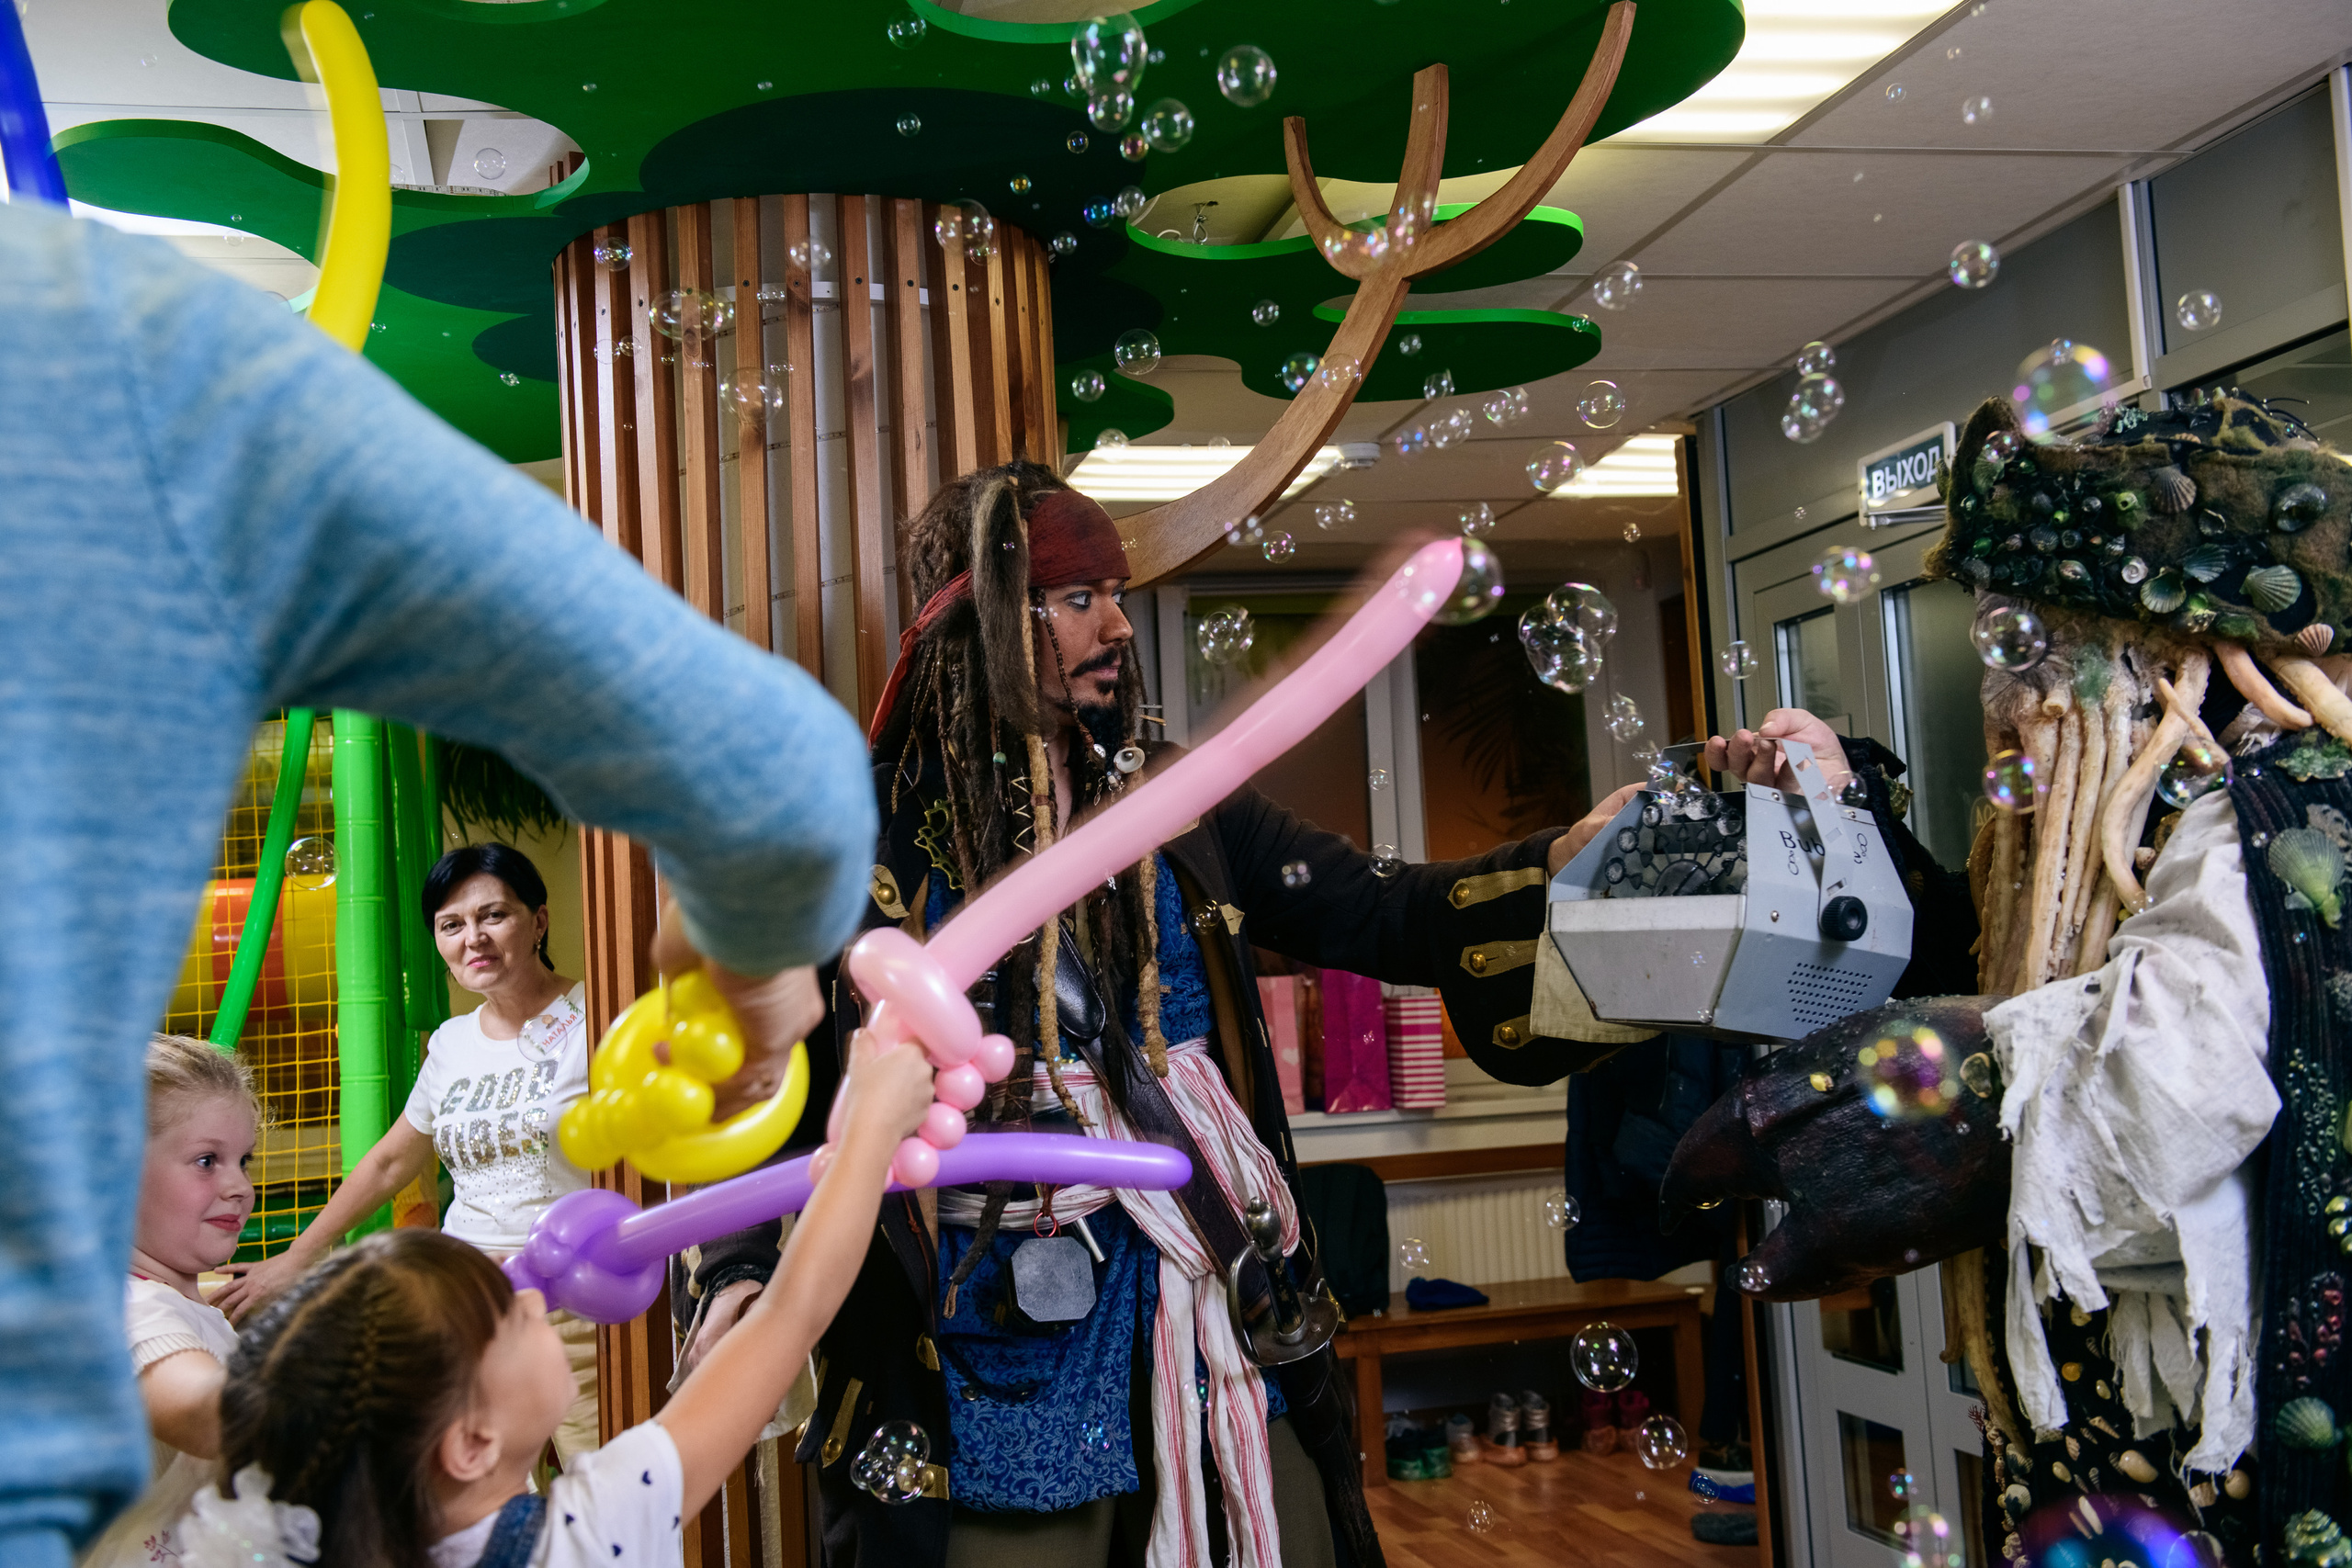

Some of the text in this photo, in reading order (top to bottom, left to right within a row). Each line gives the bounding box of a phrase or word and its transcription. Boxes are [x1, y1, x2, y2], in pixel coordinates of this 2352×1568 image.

[1871, 446, 1939, 498] ВЫХОД
[541, 1013, 578, 1047] НАТАЛЬЯ
[439, 1060, 559, 1116] GOOD
[433, 1107, 548, 1170] VIBES
